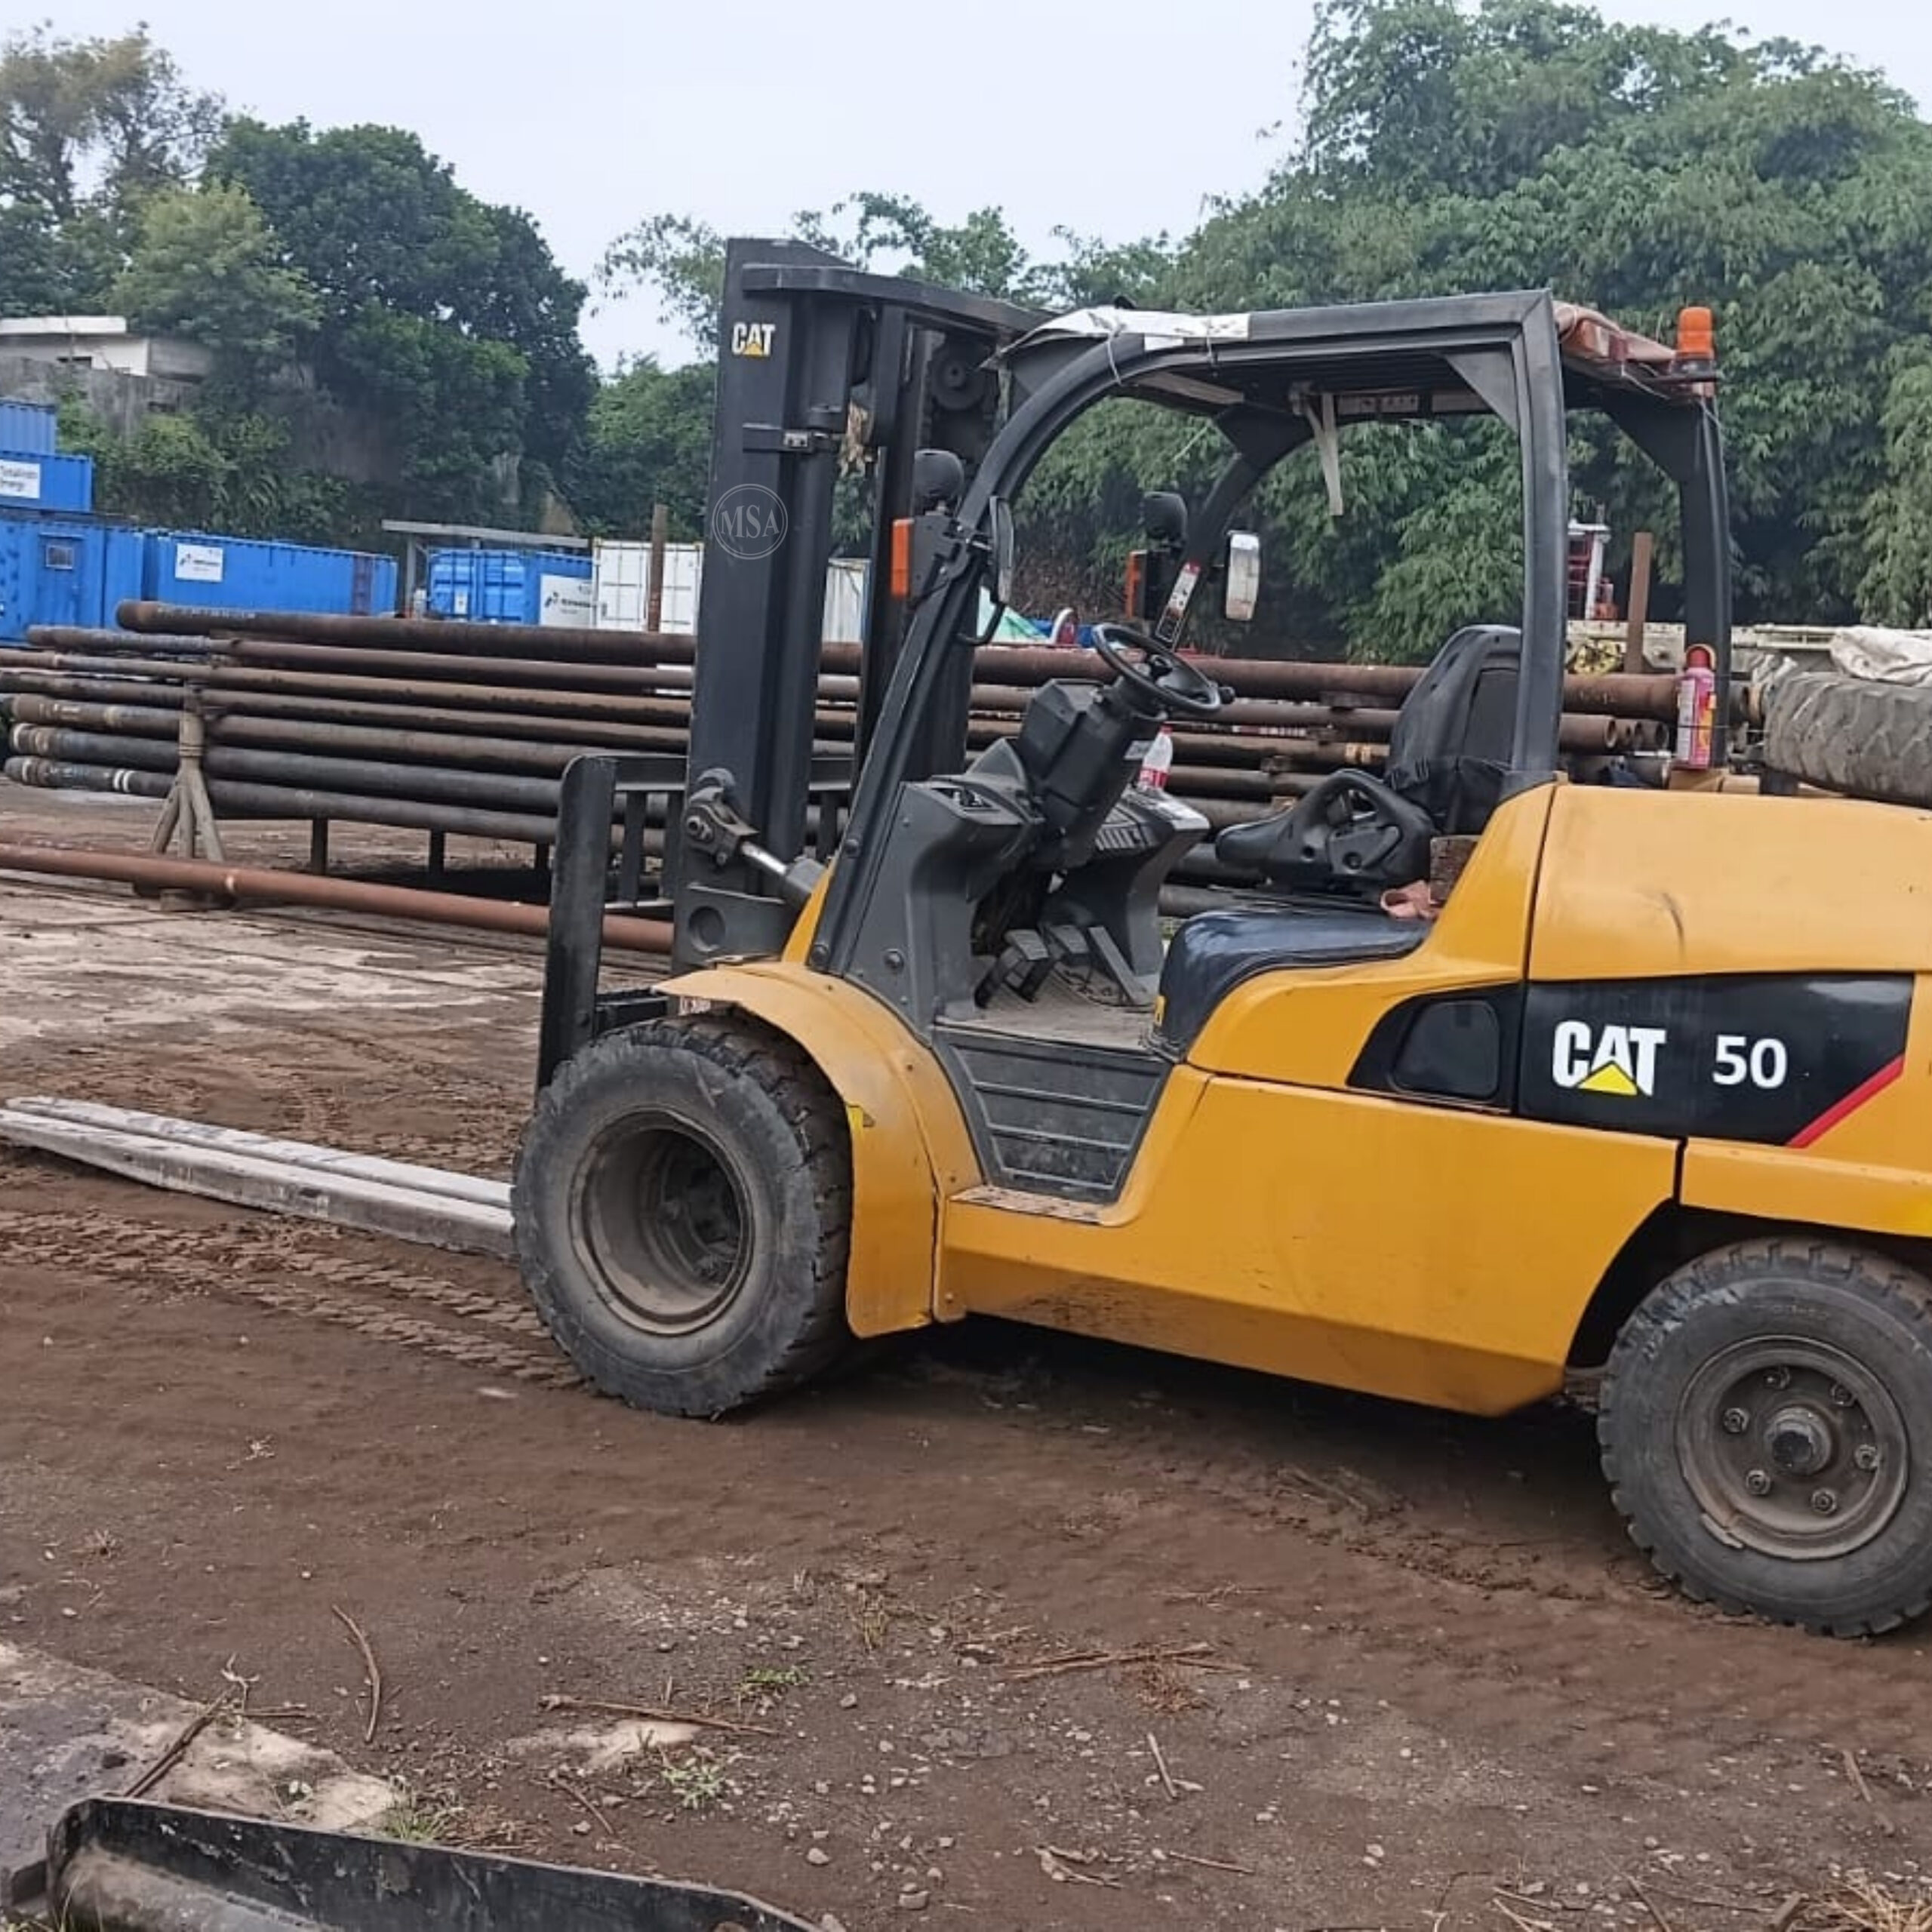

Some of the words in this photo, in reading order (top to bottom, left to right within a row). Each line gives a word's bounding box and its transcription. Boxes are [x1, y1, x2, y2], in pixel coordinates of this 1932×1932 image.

[731, 322, 776, 357] CAT
[1552, 1020, 1666, 1097] CAT
[1712, 1034, 1787, 1088] 50
